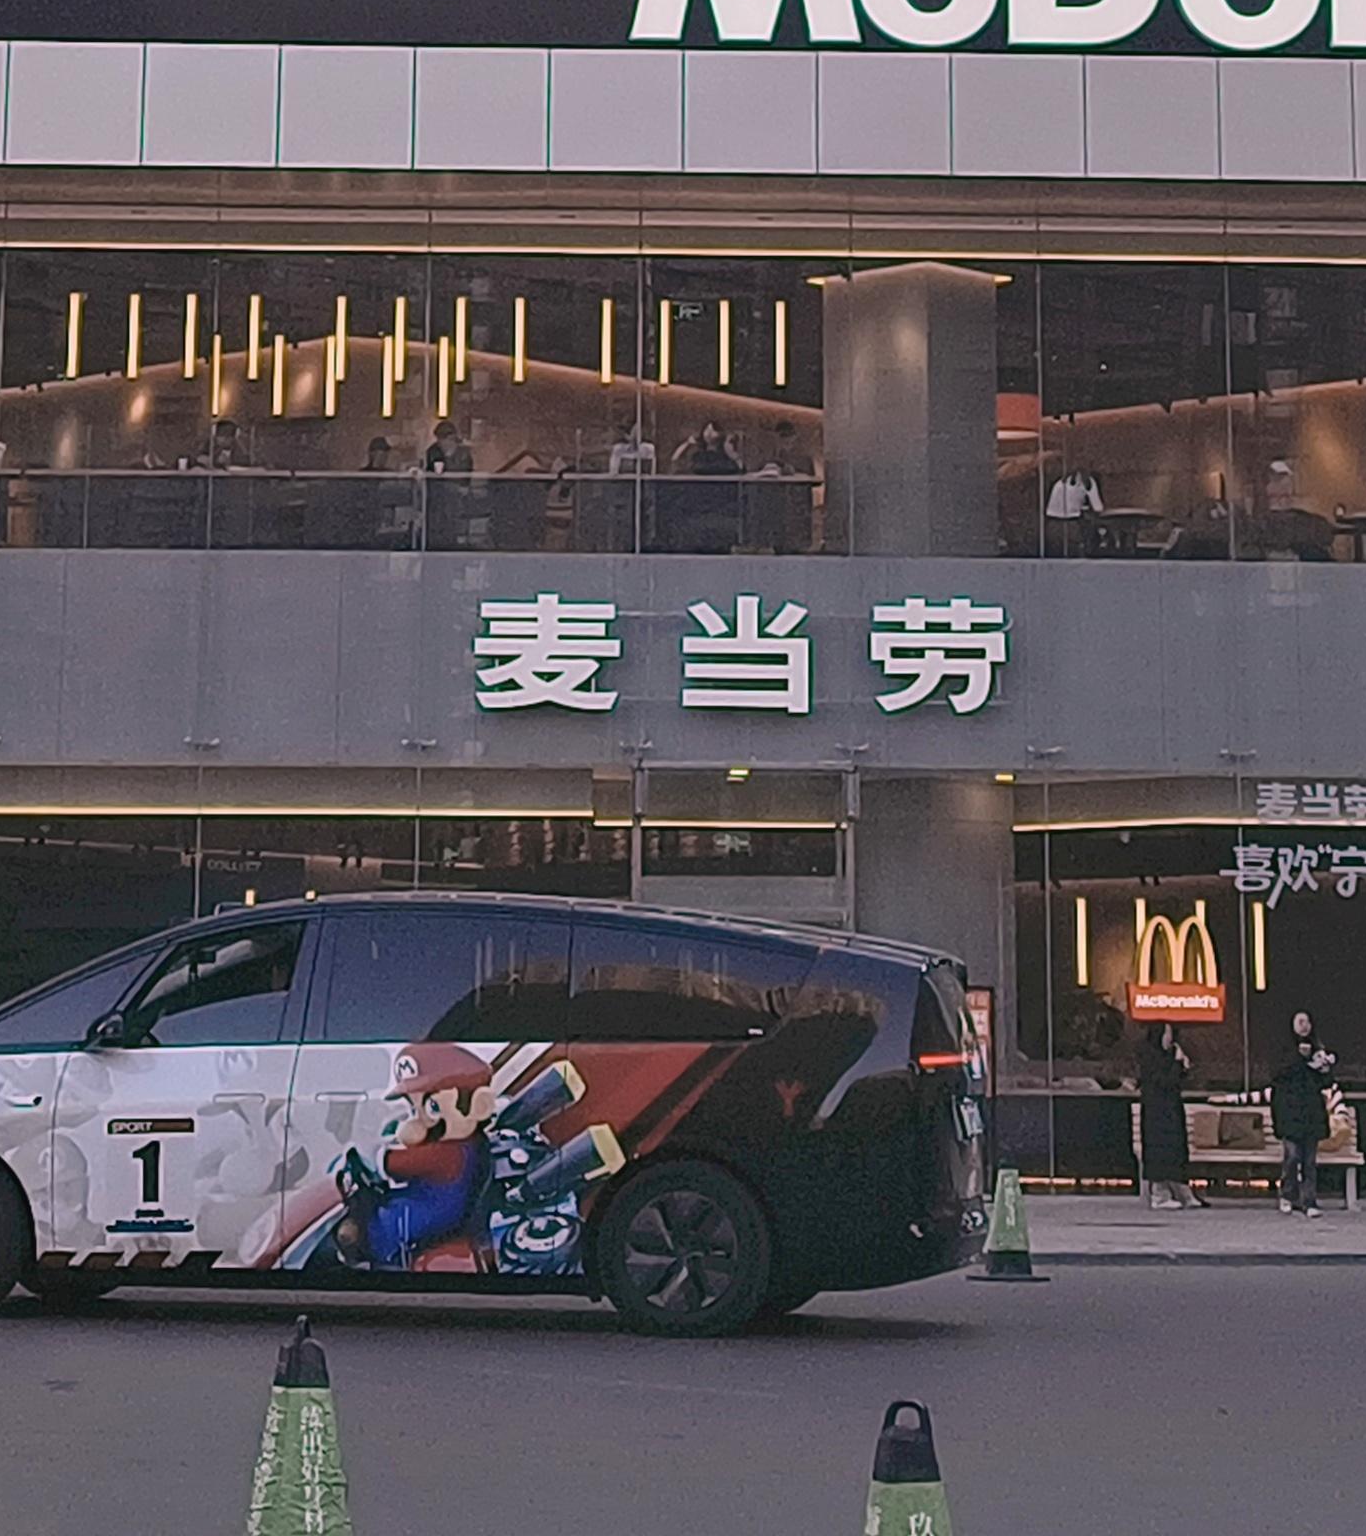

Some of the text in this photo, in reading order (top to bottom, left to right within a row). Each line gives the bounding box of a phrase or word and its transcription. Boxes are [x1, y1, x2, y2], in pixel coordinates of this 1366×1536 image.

[473, 593, 1008, 716] 麦当劳
[132, 1140, 161, 1203] 1
